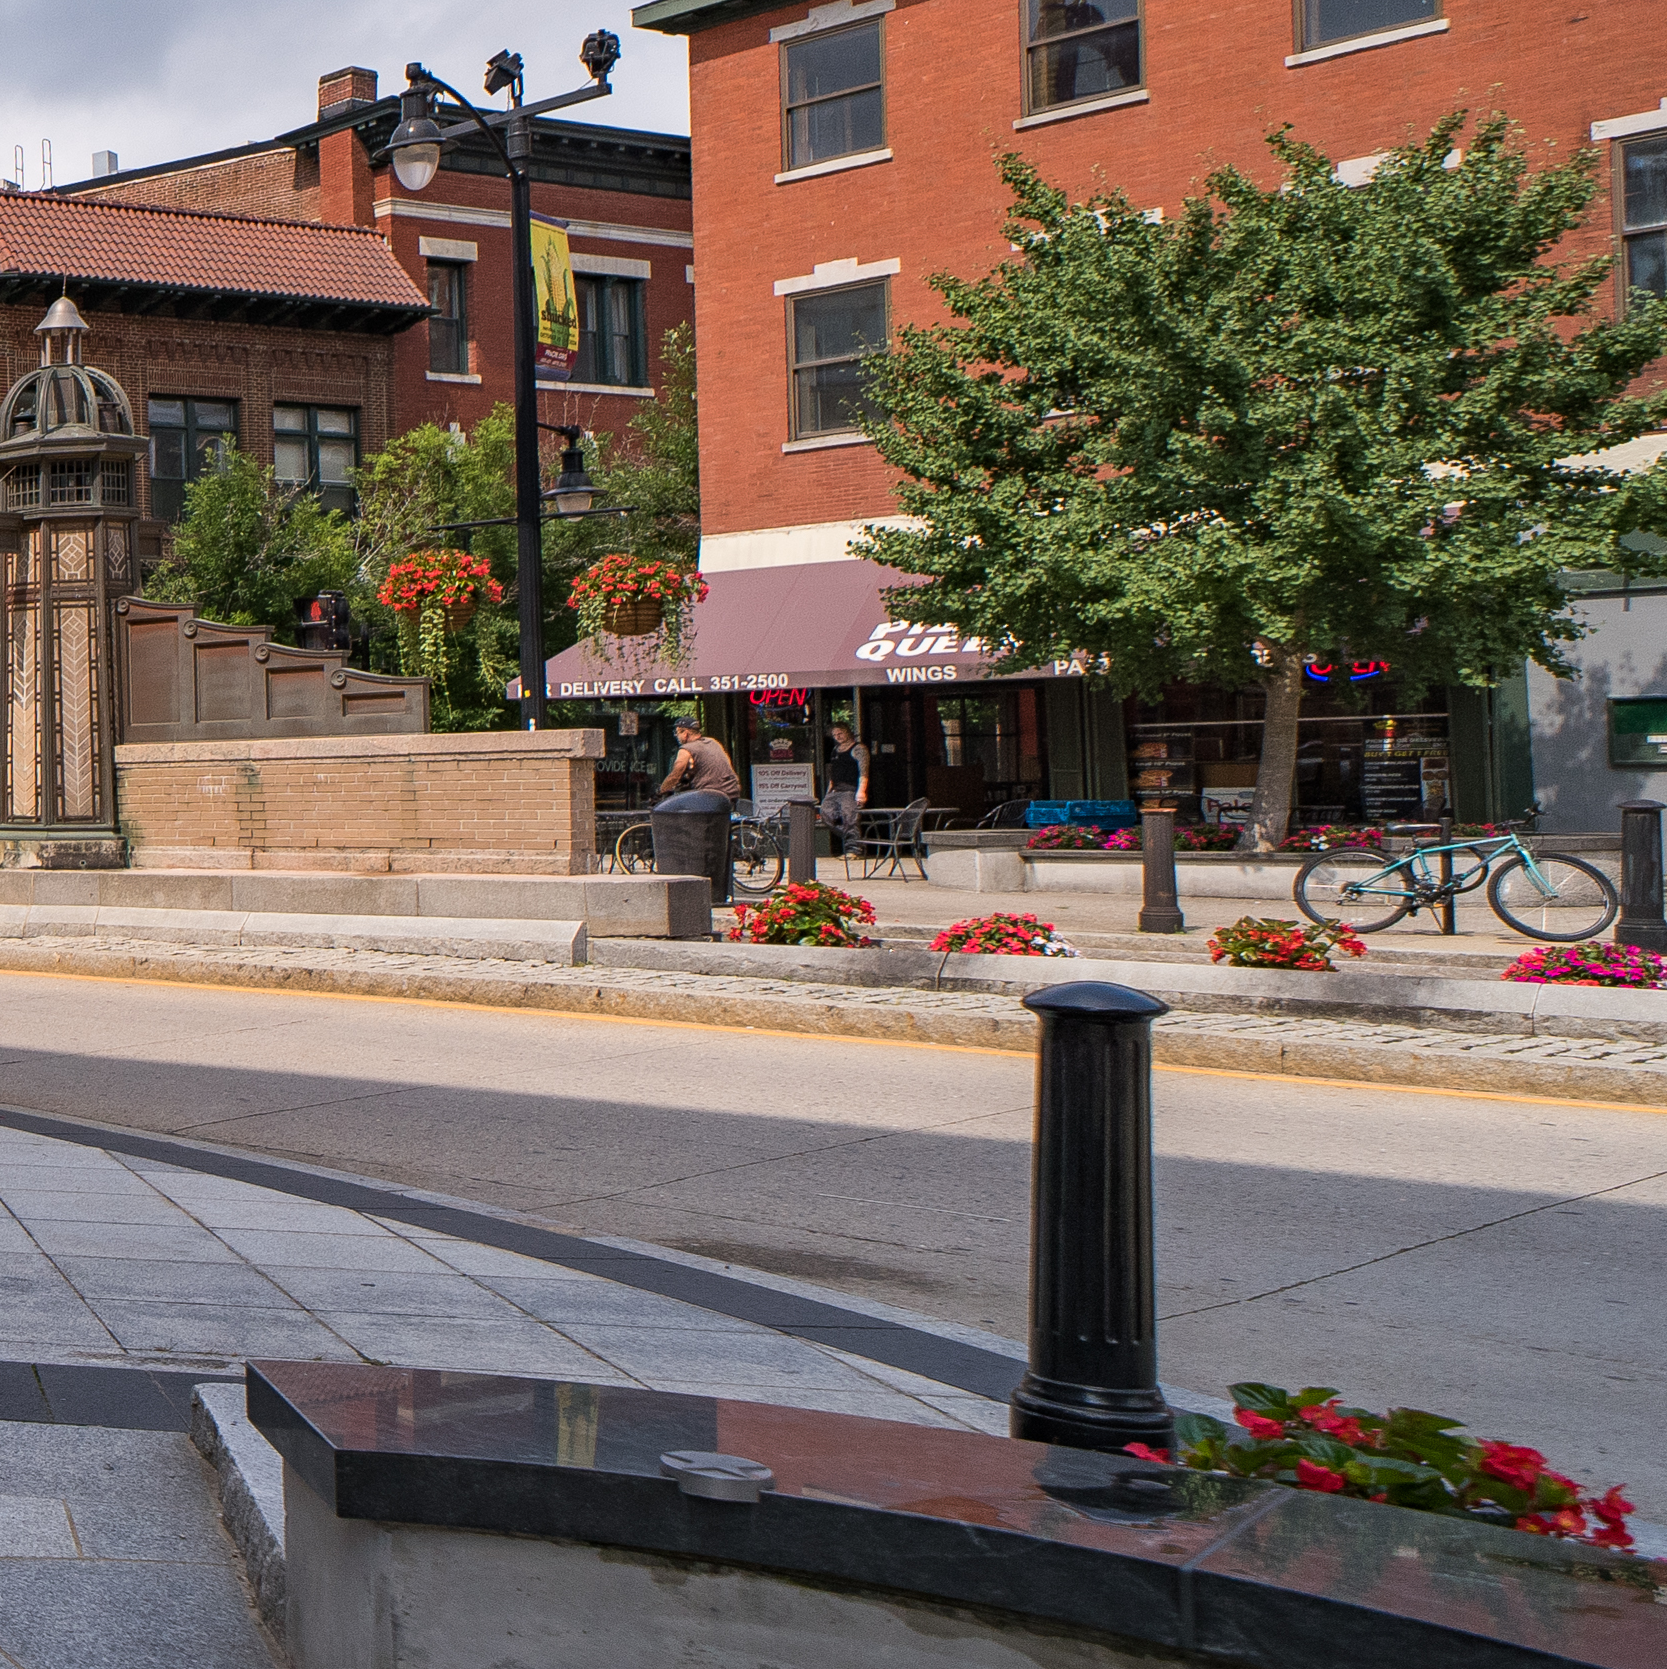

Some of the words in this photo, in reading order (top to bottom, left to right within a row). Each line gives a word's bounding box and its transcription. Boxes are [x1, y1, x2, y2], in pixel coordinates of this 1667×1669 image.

[886, 665, 957, 683] WINGS
[560, 678, 645, 696] DELIVERY
[653, 678, 703, 693] CALL
[710, 673, 789, 691] 351-2500
[750, 688, 807, 706] OPEN
[780, 782, 807, 790] Carryout
